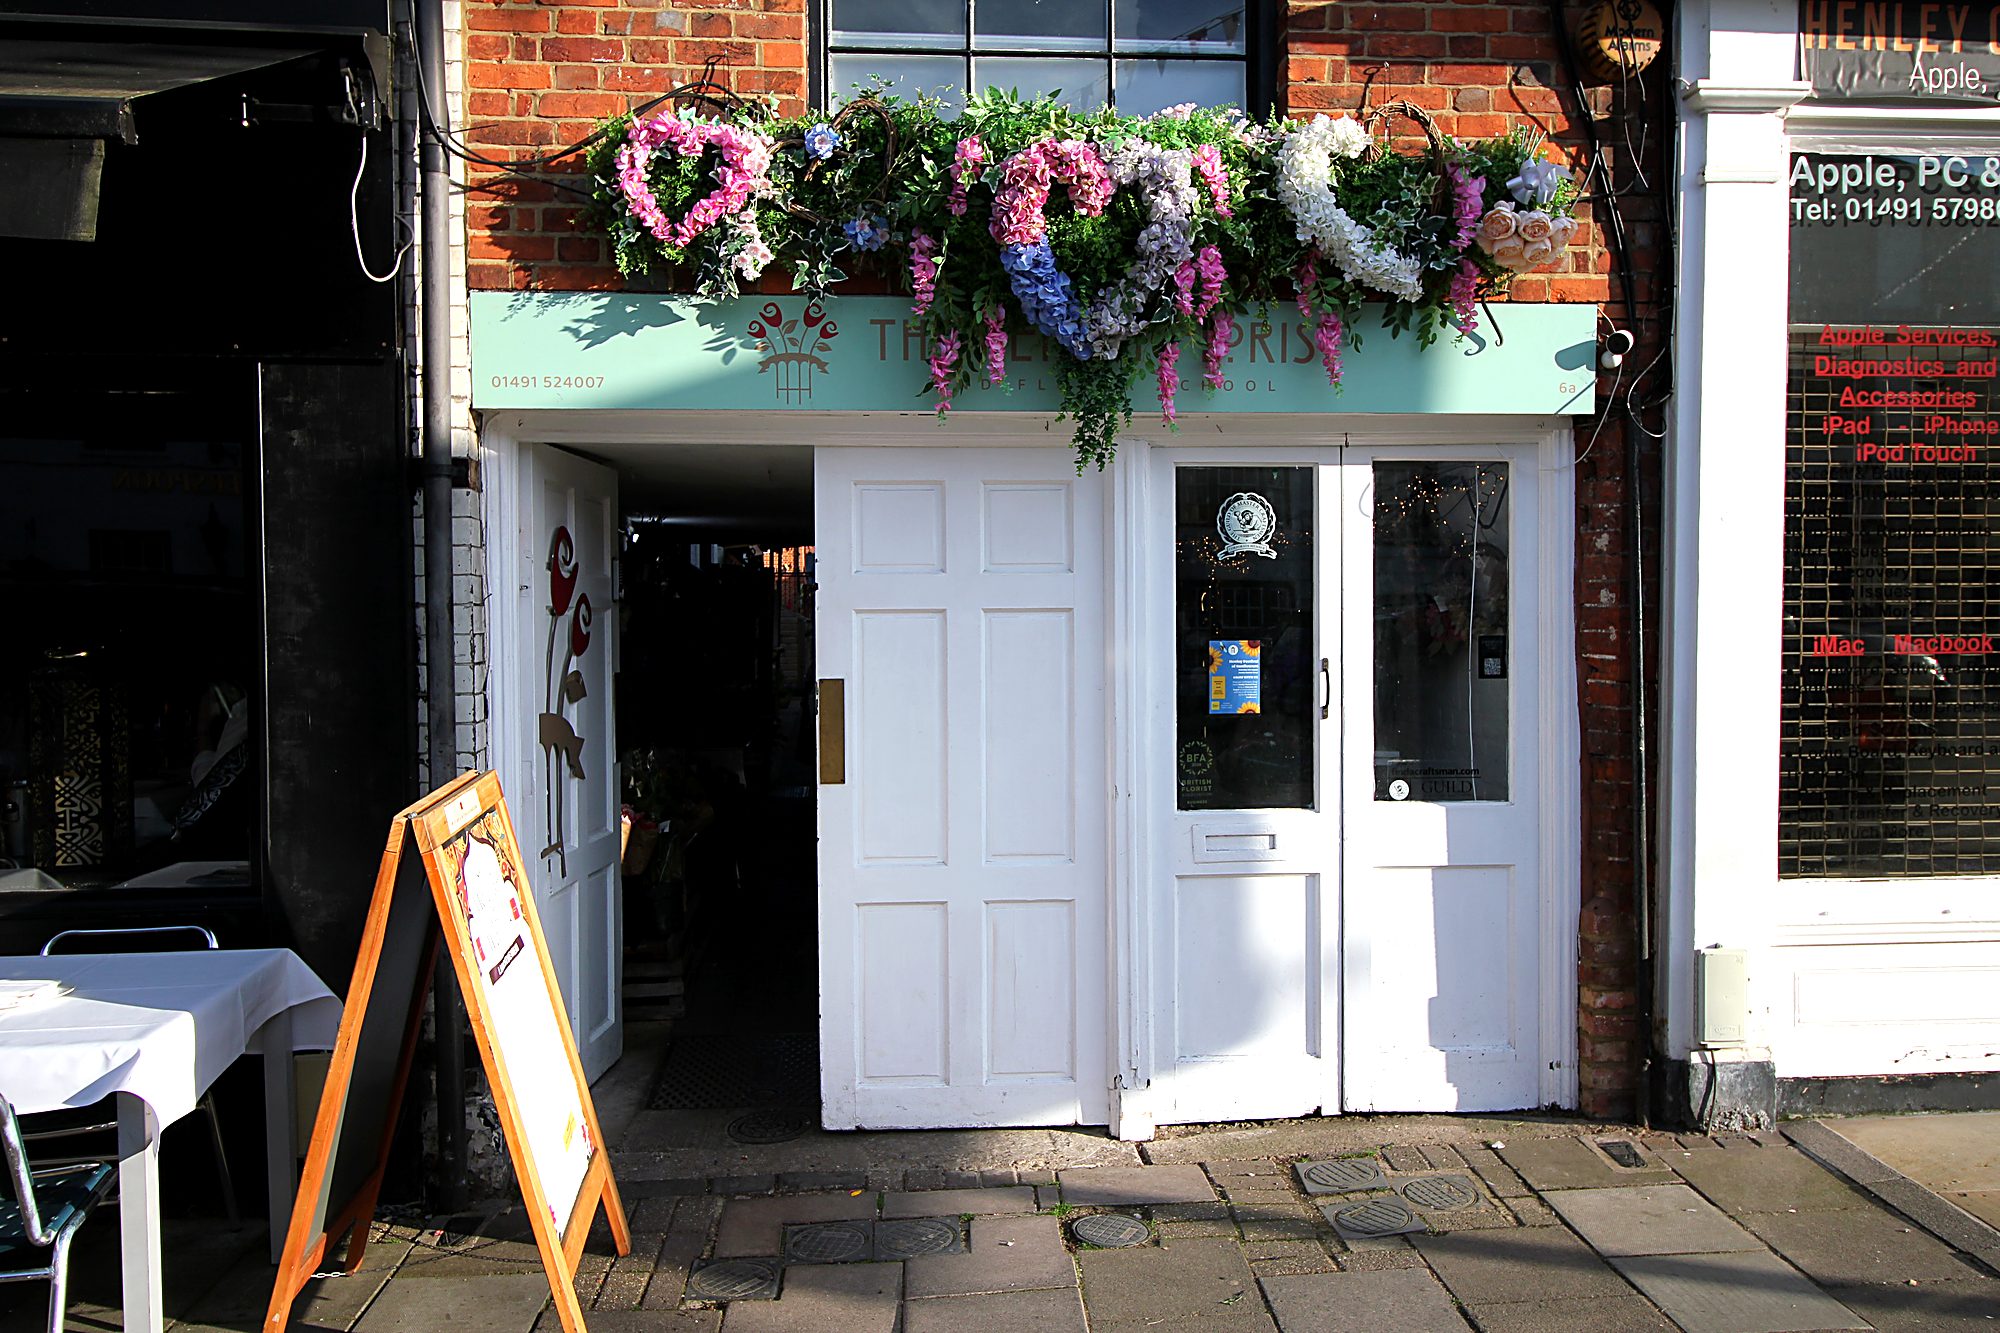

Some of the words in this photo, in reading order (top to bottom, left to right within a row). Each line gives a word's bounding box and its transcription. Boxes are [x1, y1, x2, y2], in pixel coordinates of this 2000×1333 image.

[1605, 25, 1655, 37] Modern
[1804, 1, 1970, 53] HENLEY
[1607, 38, 1651, 51] Aams
[1909, 61, 1987, 93] Apple,
[1789, 156, 1904, 194] Apple,
[1918, 157, 1968, 187] PC
[1790, 198, 1837, 220] Tel:
[1845, 198, 1921, 220] 01491
[1819, 325, 1885, 346] Apple
[1896, 325, 1997, 347] Services,
[1815, 355, 1945, 379] Diagnostics
[1956, 358, 1996, 377] and
[491, 375, 537, 388] 01491
[543, 376, 604, 388] 524007
[1559, 382, 1576, 393] 6a
[1840, 386, 1976, 407] Accessories
[1822, 416, 1870, 435] iPad
[1924, 415, 1999, 435] iPhone
[1856, 443, 1904, 462] iPod
[1911, 443, 1977, 462] Touch
[1813, 636, 1865, 656] iMac
[1894, 633, 1994, 655] Macbook
[1186, 754, 1206, 762] BFA
[1422, 781, 1473, 793] GUILD
